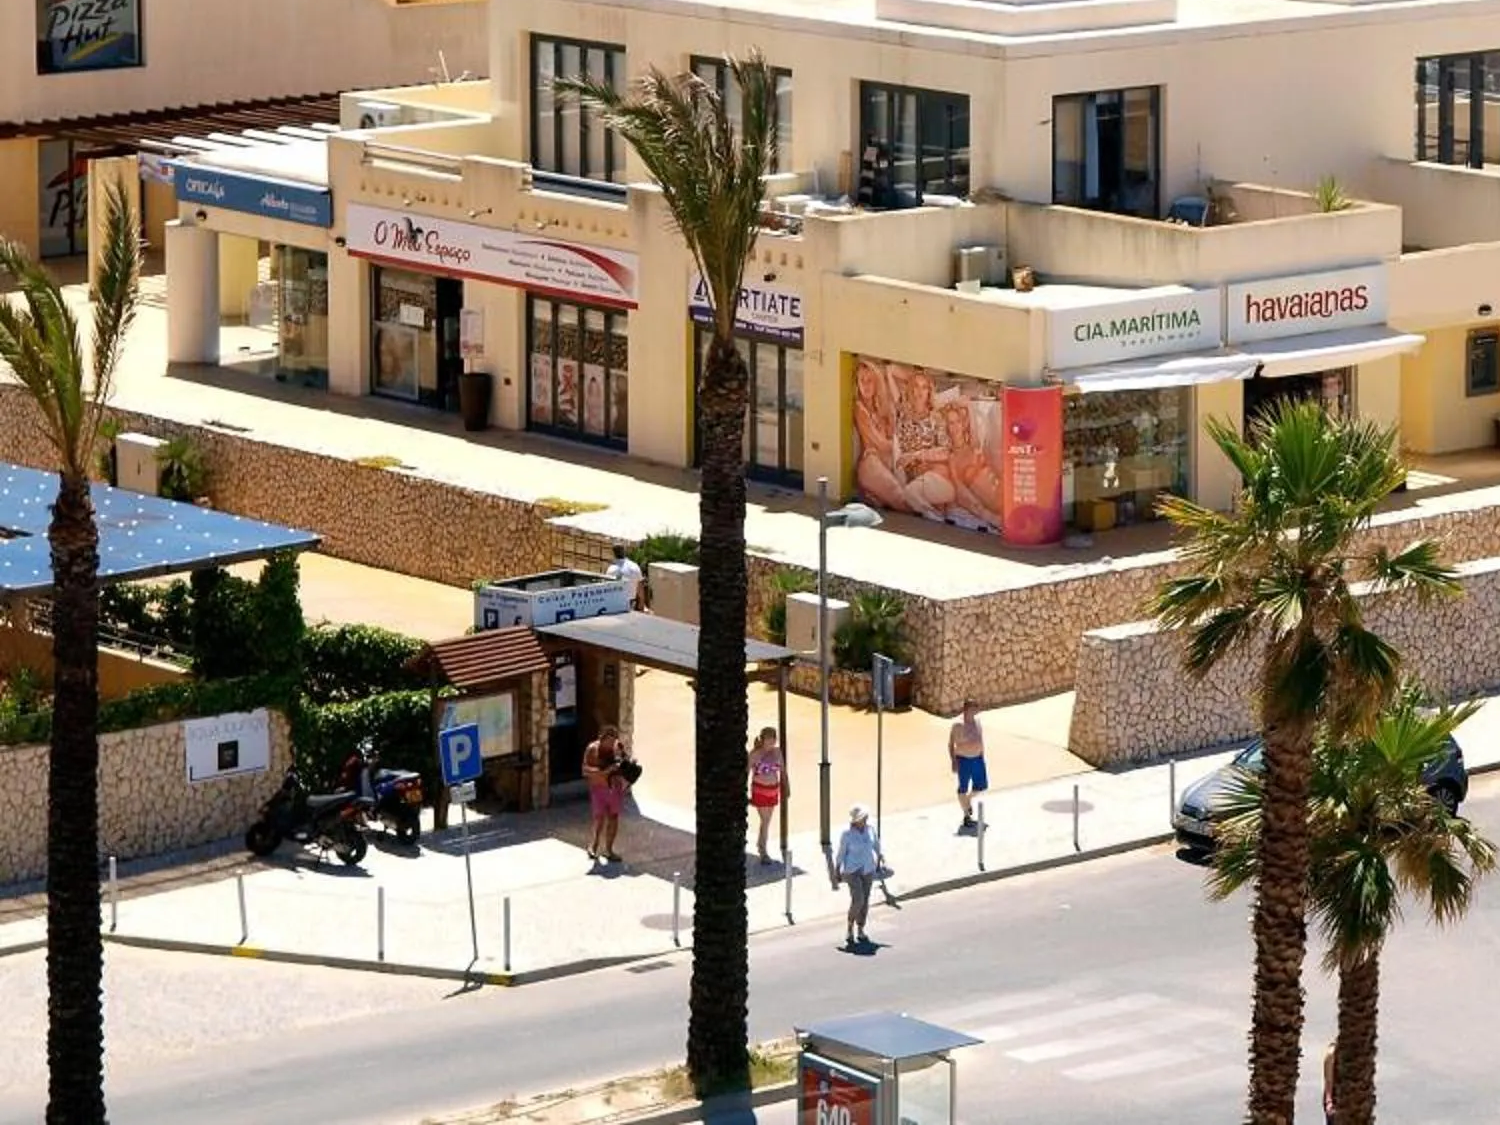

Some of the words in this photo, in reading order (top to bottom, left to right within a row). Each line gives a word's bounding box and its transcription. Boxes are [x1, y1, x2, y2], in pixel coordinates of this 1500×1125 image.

[60, 16, 118, 54] Hut
[374, 220, 388, 245] O
[425, 230, 471, 263] Espaço
[739, 287, 801, 318] RTIATE
[1246, 285, 1369, 324] havaianas
[1073, 308, 1201, 342] CIA.MARÍTIMA
[447, 733, 473, 776] P
